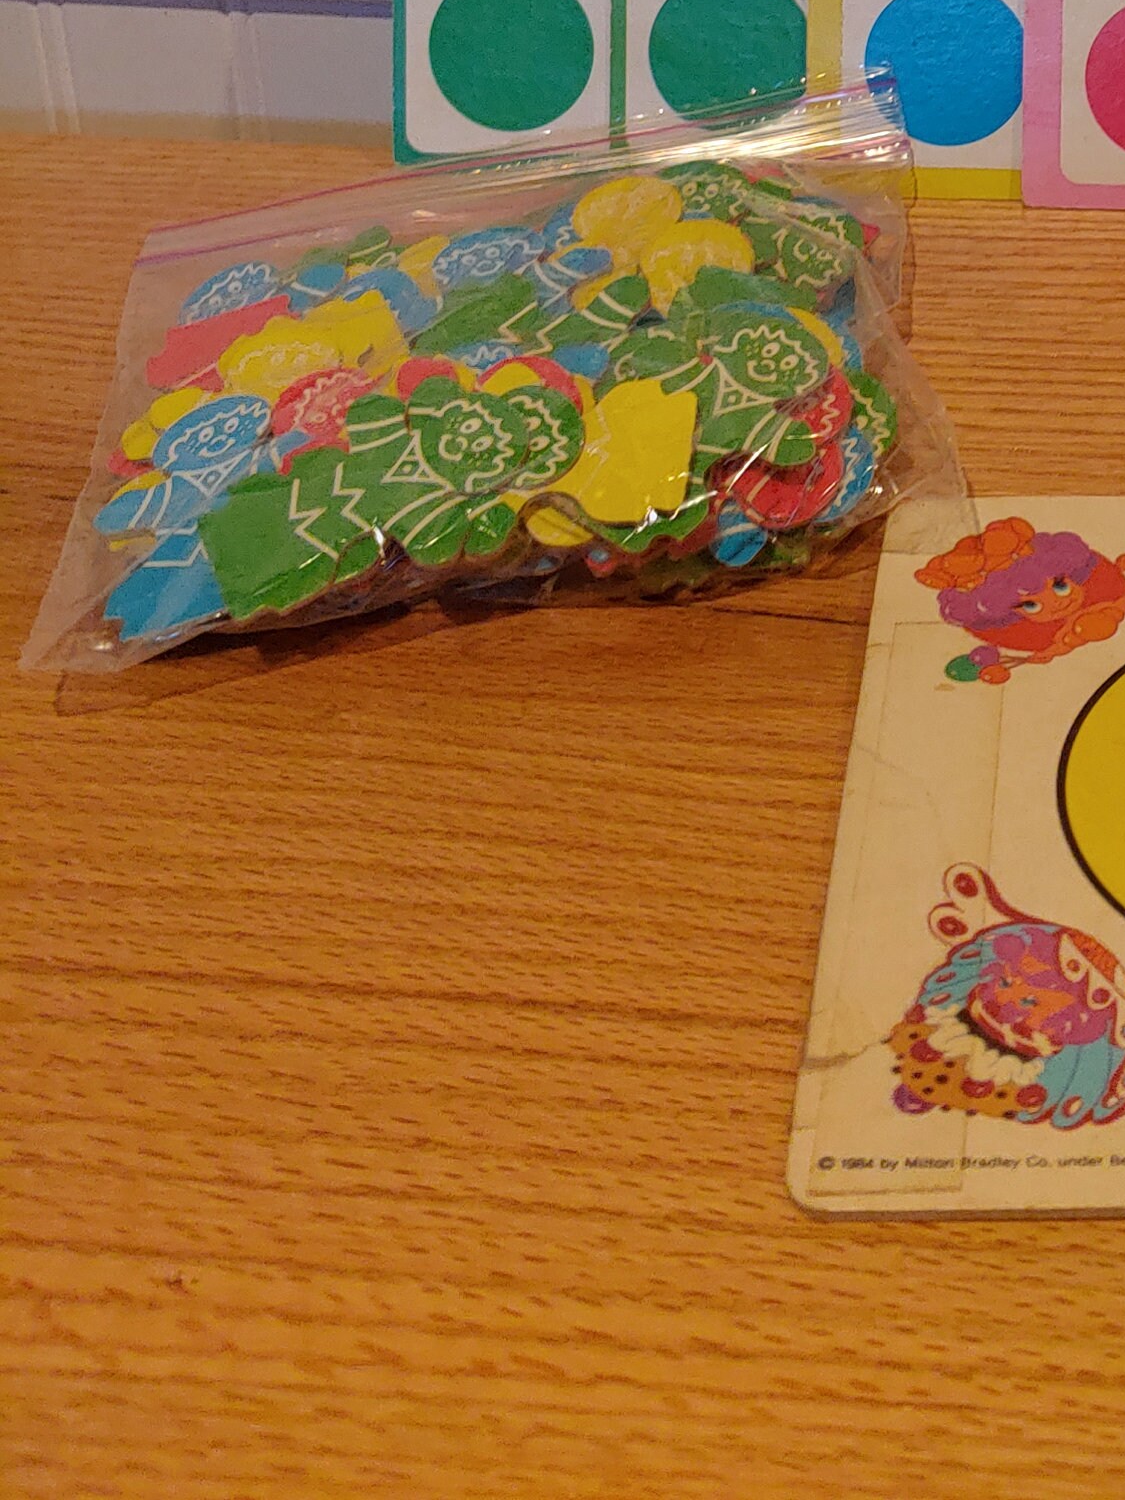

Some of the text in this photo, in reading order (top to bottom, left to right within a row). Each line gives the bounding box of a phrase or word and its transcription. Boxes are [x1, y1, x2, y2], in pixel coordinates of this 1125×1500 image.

[880, 1158, 899, 1172] by
[904, 1157, 954, 1169] Milton
[960, 1156, 1021, 1170] Bradley
[1058, 1156, 1103, 1167] under
